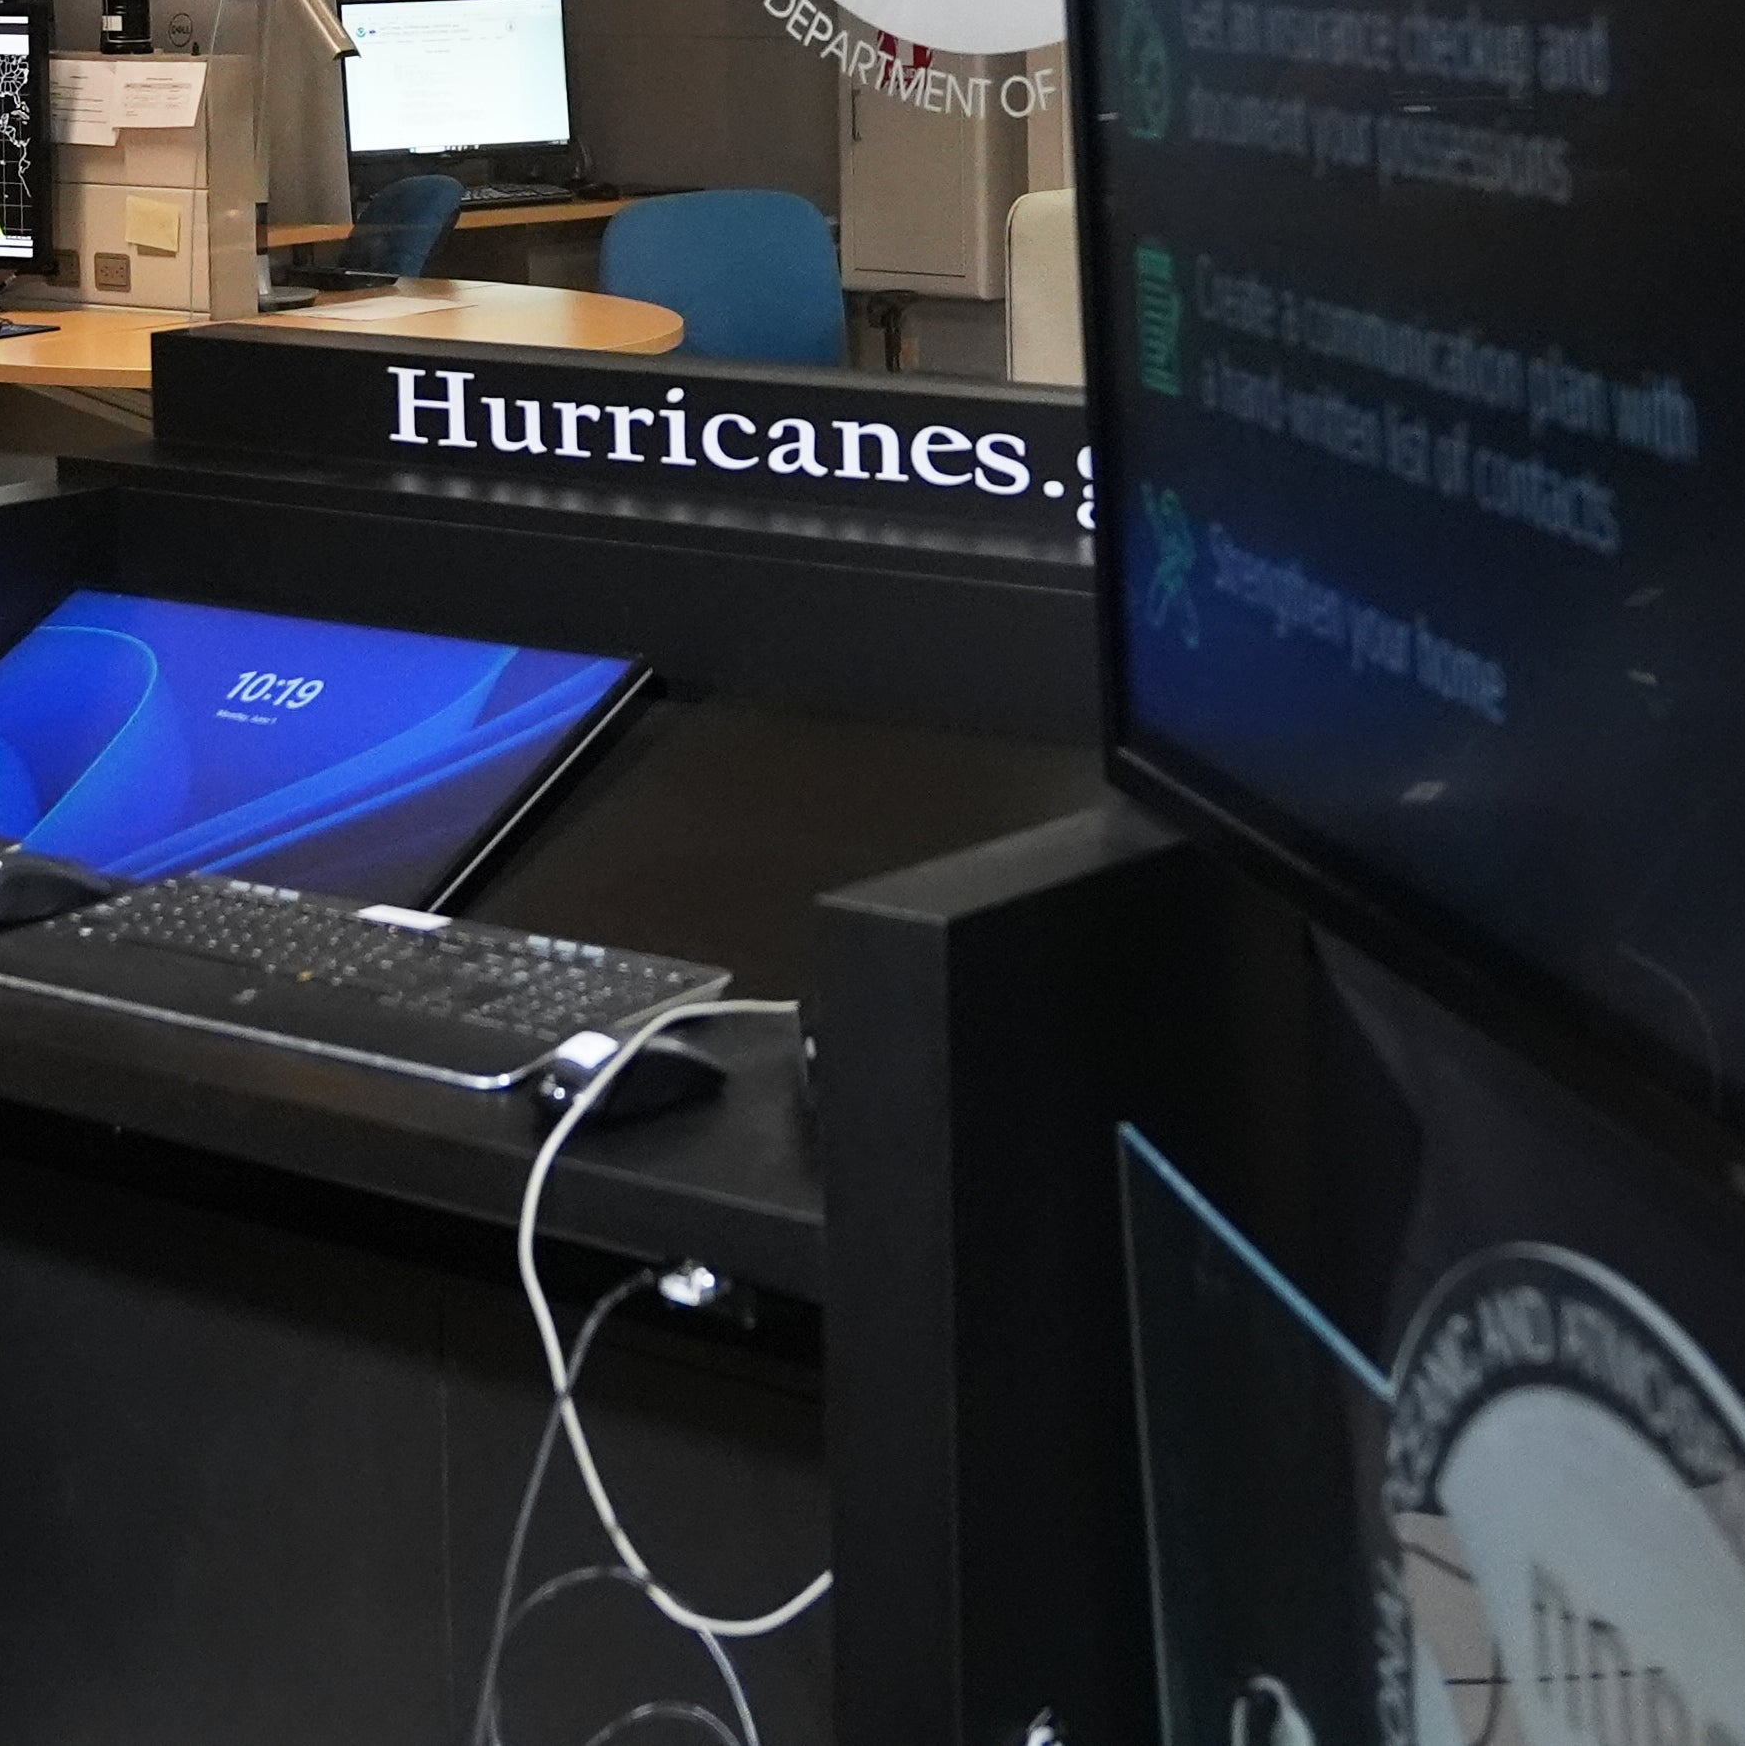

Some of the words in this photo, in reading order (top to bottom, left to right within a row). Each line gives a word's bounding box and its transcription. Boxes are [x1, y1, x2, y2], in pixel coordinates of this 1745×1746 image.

[1539, 5, 1613, 96] and
[1000, 66, 1058, 120] OF
[1528, 342, 1610, 436] plan
[226, 671, 324, 709] 10:19
